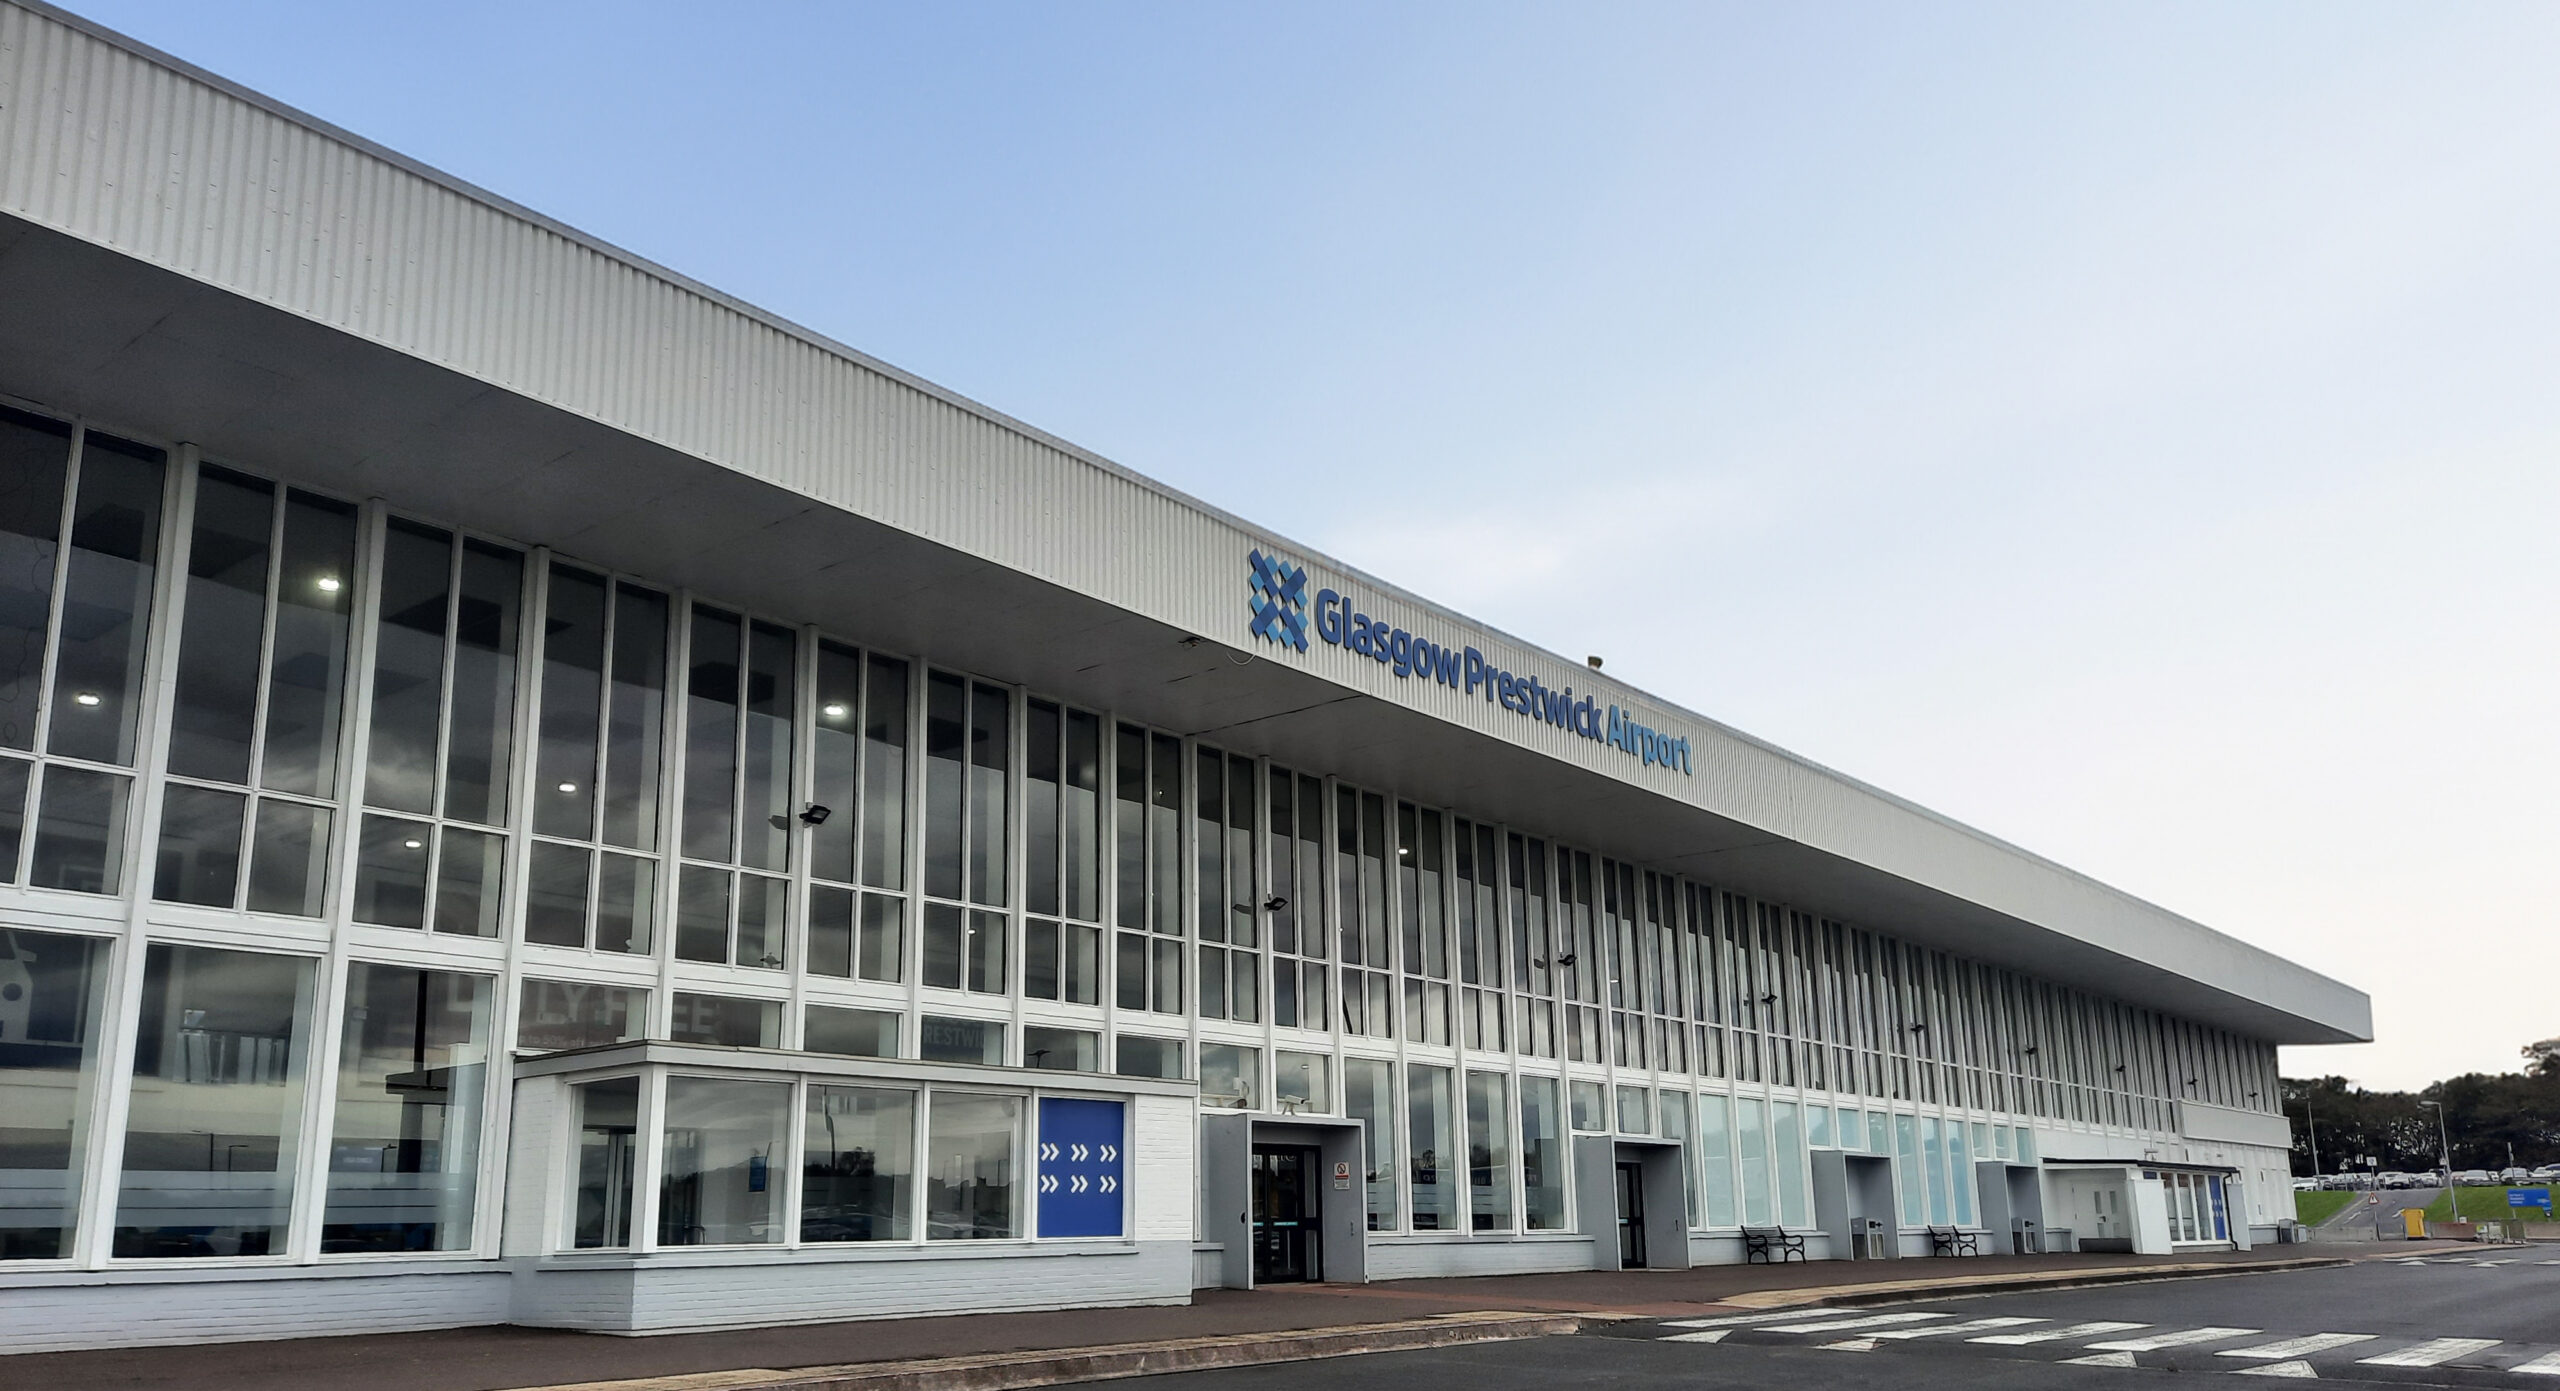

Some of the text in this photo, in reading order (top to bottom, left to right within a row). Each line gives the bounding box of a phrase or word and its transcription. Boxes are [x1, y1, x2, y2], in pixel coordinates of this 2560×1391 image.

[1316, 587, 1693, 776] Glasgow Prestwick Airport
